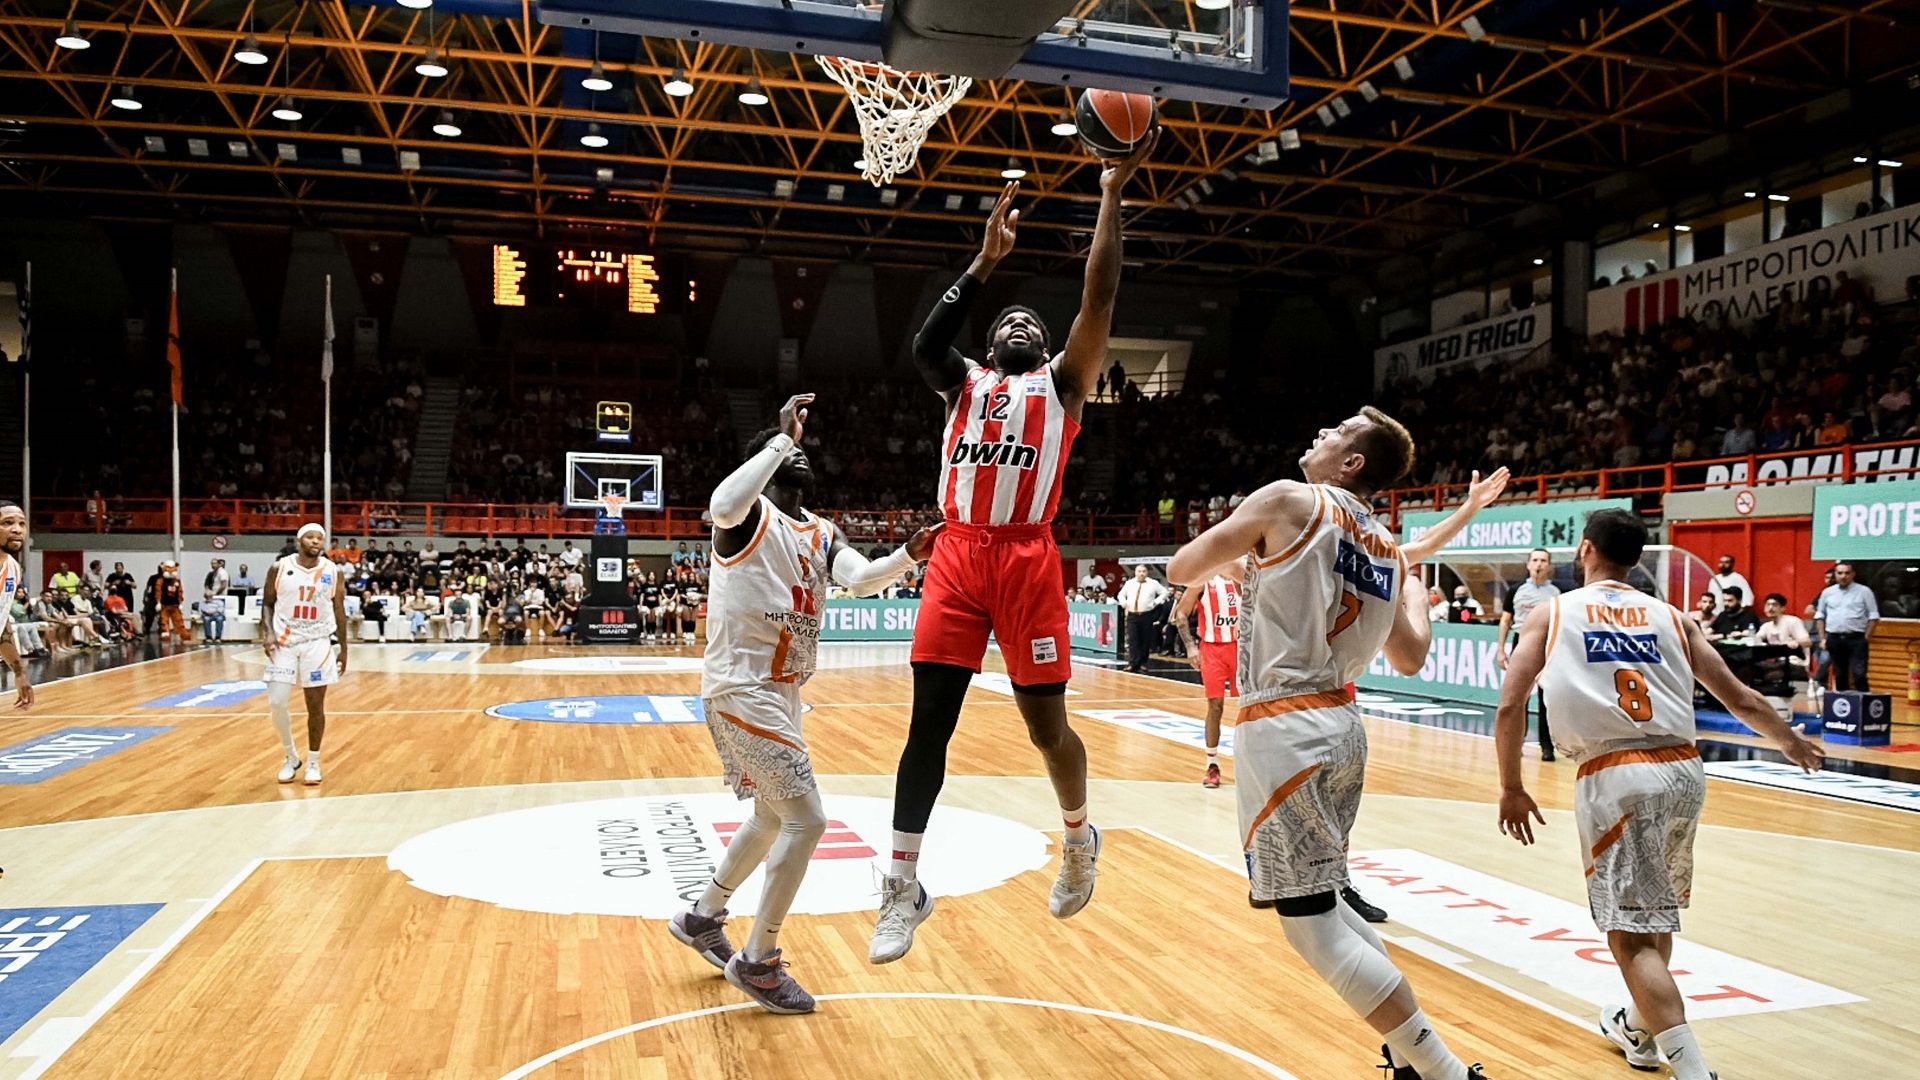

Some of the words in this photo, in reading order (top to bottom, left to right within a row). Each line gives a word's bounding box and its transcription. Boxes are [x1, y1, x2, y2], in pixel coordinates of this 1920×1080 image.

[1684, 210, 1920, 298] ΜΗΤΡΟΠΟΛΙΤΙΚ
[1418, 333, 1462, 369] MED
[1464, 313, 1536, 358] FRIGO
[978, 391, 1012, 420] 12
[949, 434, 1038, 469] bwin
[1703, 447, 1920, 493] PROMITH
[1470, 520, 1534, 547] SHAKES
[1829, 501, 1920, 538] PROTE
[298, 586, 316, 602] 17
[1613, 668, 1654, 723] 8
[596, 818, 651, 879] ΚΟΛΛΕΓΙΟ
